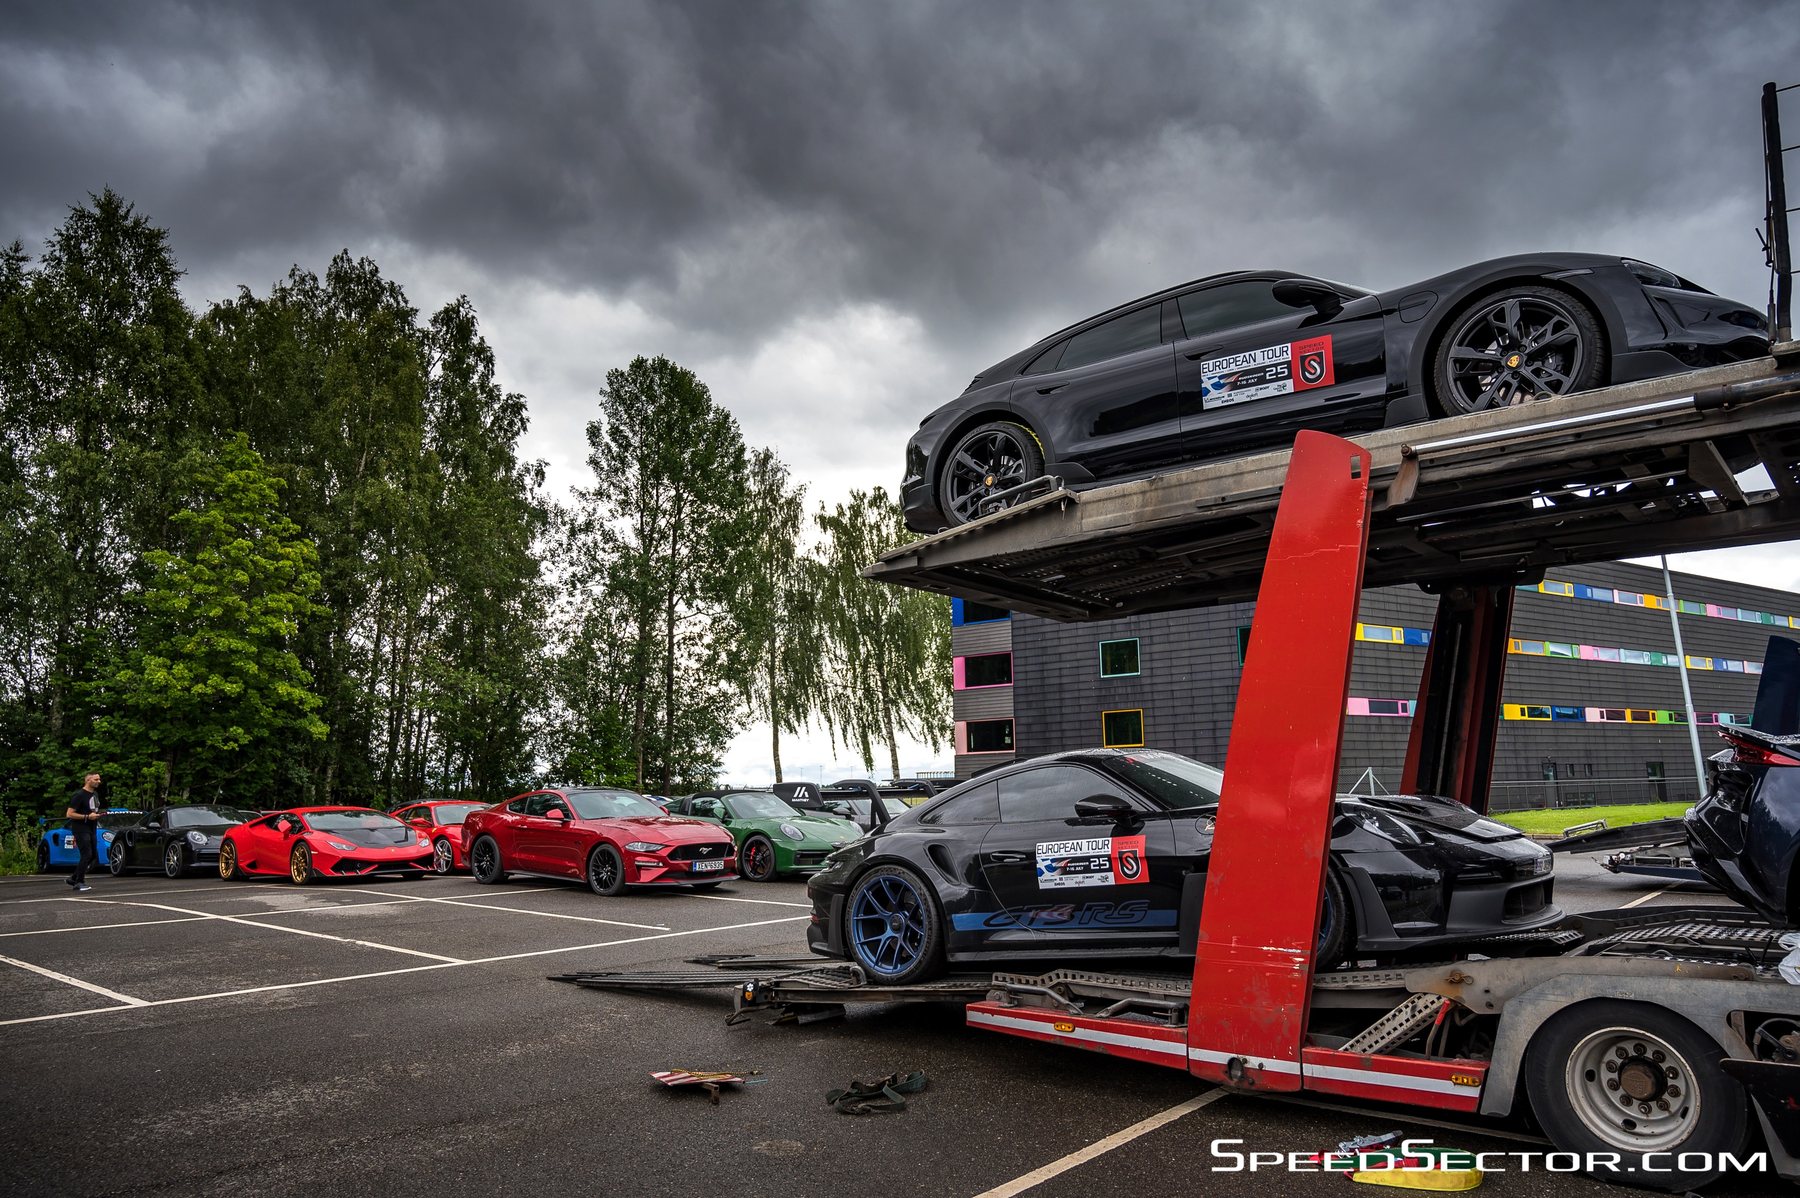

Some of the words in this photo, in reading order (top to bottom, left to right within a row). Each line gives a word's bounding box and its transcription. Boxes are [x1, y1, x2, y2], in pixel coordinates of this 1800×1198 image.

[1201, 352, 1257, 374] EUROPEAN
[1260, 345, 1290, 361] TOUR
[1265, 364, 1289, 380] 25
[1036, 841, 1083, 855] EUROPEAN
[1085, 839, 1110, 851] TOUR
[1090, 857, 1110, 870] 25
[1078, 899, 1150, 925] RS
